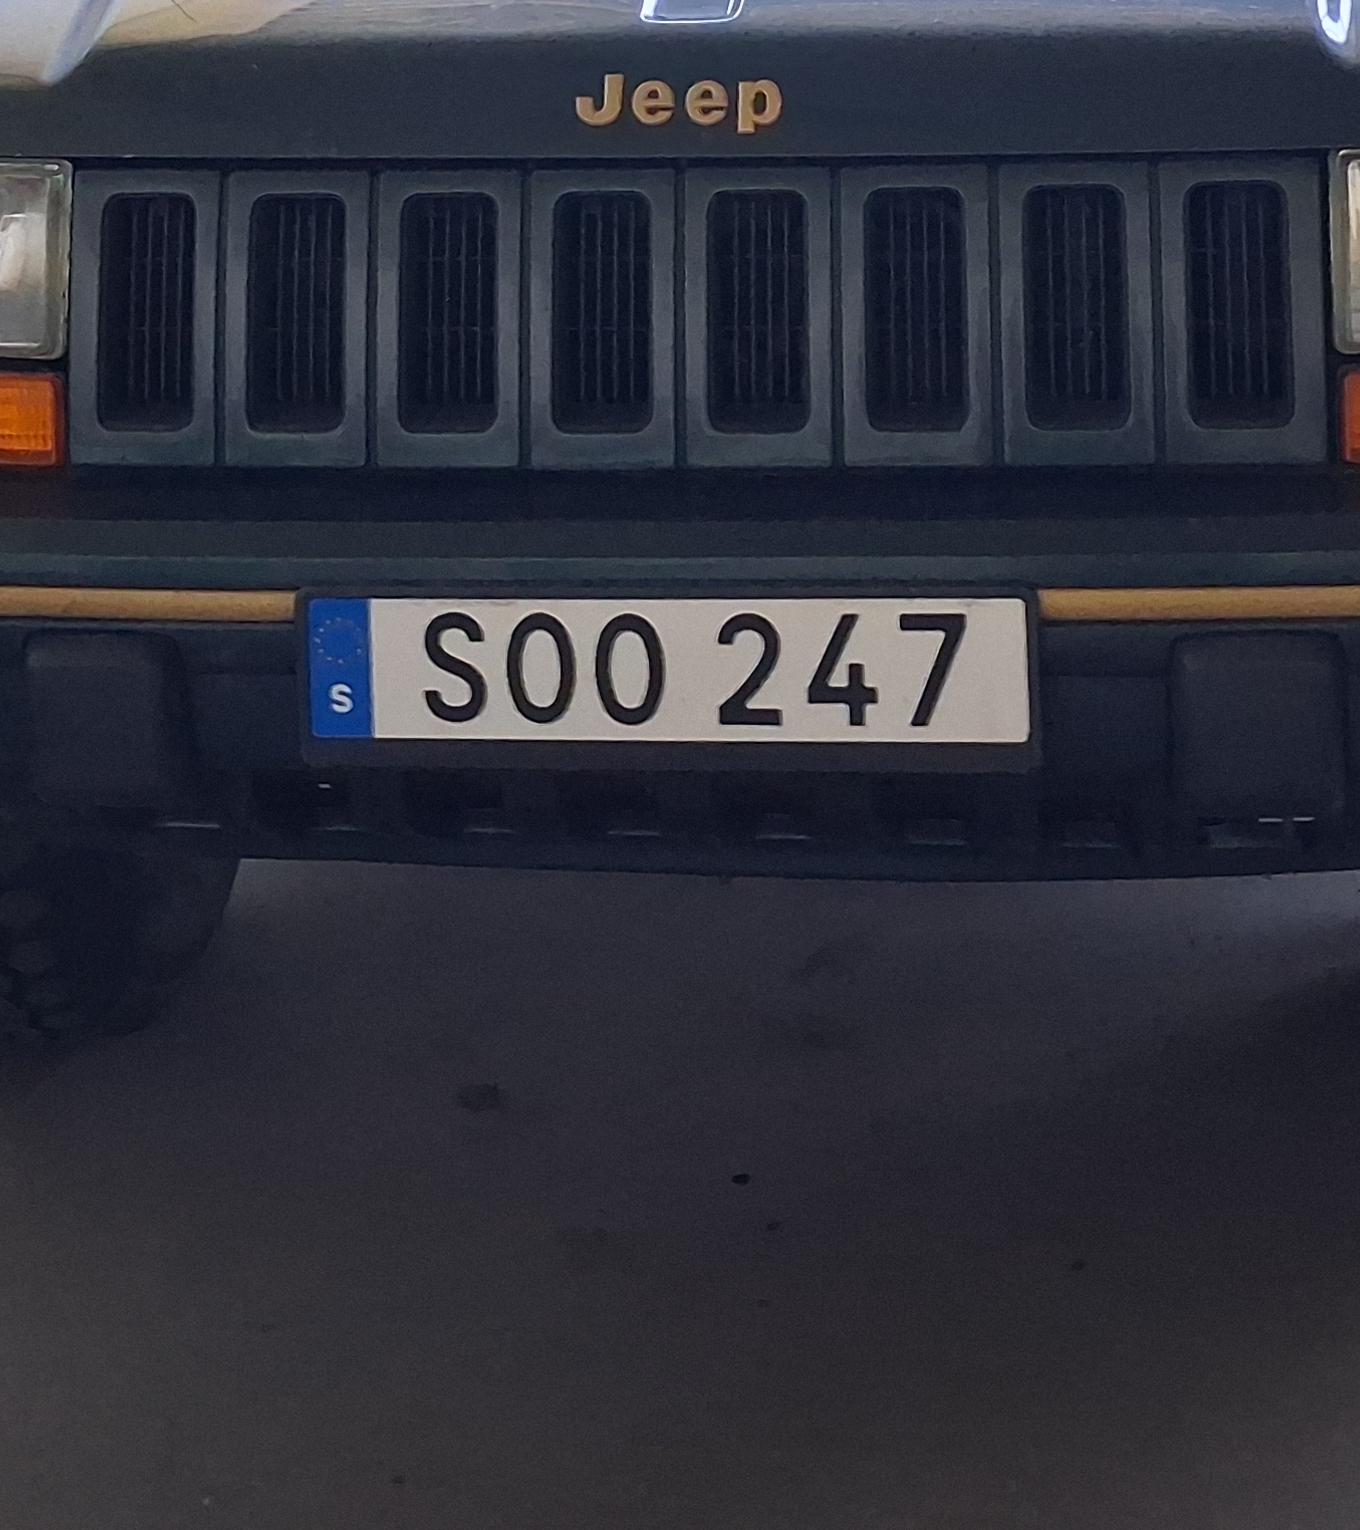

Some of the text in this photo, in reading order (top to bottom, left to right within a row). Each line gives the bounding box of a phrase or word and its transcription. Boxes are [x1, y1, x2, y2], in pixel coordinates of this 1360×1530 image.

[575, 73, 782, 134] Jeep
[329, 683, 354, 713] S
[424, 611, 967, 726] SOO 247
